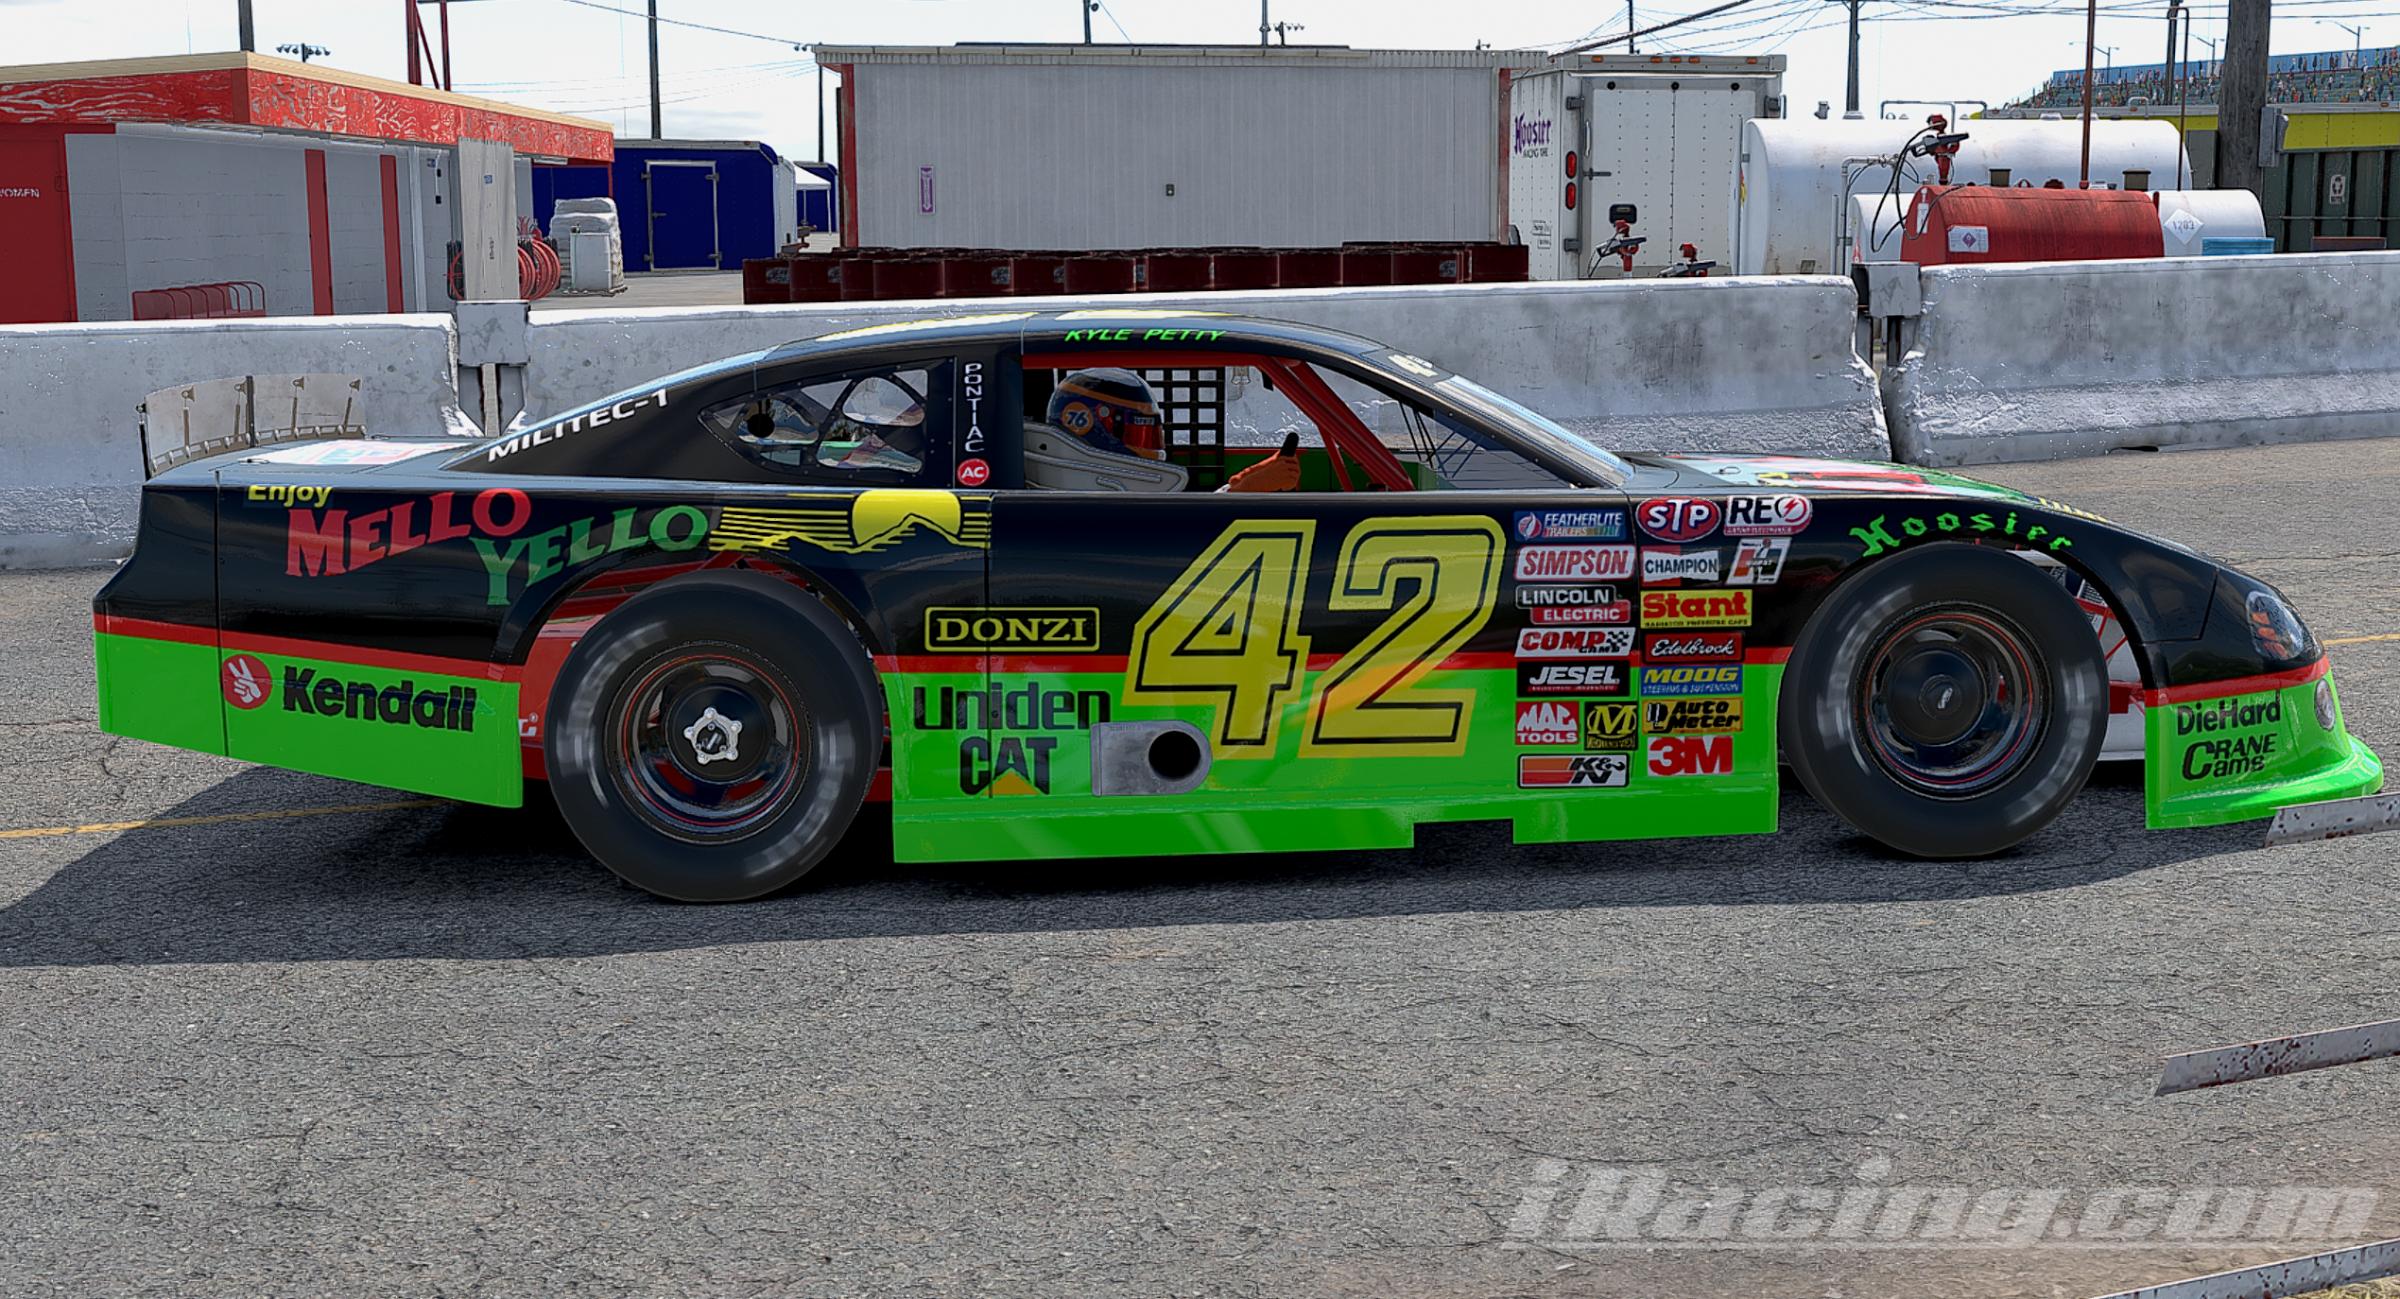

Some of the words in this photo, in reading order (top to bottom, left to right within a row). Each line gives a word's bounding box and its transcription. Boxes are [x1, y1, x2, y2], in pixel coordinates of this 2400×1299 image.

[1064, 328, 1134, 341] KYLE
[1143, 328, 1227, 342] PETTY
[964, 363, 985, 452] PONTIAC
[1066, 411, 1088, 427] 76
[488, 388, 668, 462] MILITEC-1
[961, 466, 985, 479] AC
[247, 484, 333, 508] Enjoy
[1543, 512, 1623, 527] FEATHERLITE
[1647, 499, 1710, 532] STP
[285, 487, 531, 577] MELLO
[1849, 512, 2073, 557] Hoosier
[469, 505, 709, 606] YELLO
[1523, 549, 1629, 575] SIMPSON
[1645, 557, 1718, 574] CHAMPION
[1522, 589, 1610, 604] LINCOLN
[1643, 592, 1748, 619] Stant
[1543, 608, 1621, 621] ELECTRIC
[936, 617, 1087, 642] DONZI
[1121, 515, 1507, 760] 42
[1521, 631, 1606, 652] COMP
[1651, 638, 1735, 656] Edelbrock
[1529, 666, 1620, 685] JESEL
[1644, 667, 1740, 684] MOOG
[283, 665, 477, 733] Kendall
[1671, 701, 1729, 714] Auto
[1517, 702, 1578, 731] MAC
[2177, 695, 2281, 736] DieHard
[1517, 732, 1577, 744] TOOLS
[959, 736, 1057, 795] CAT
[1648, 736, 1734, 776] 3M
